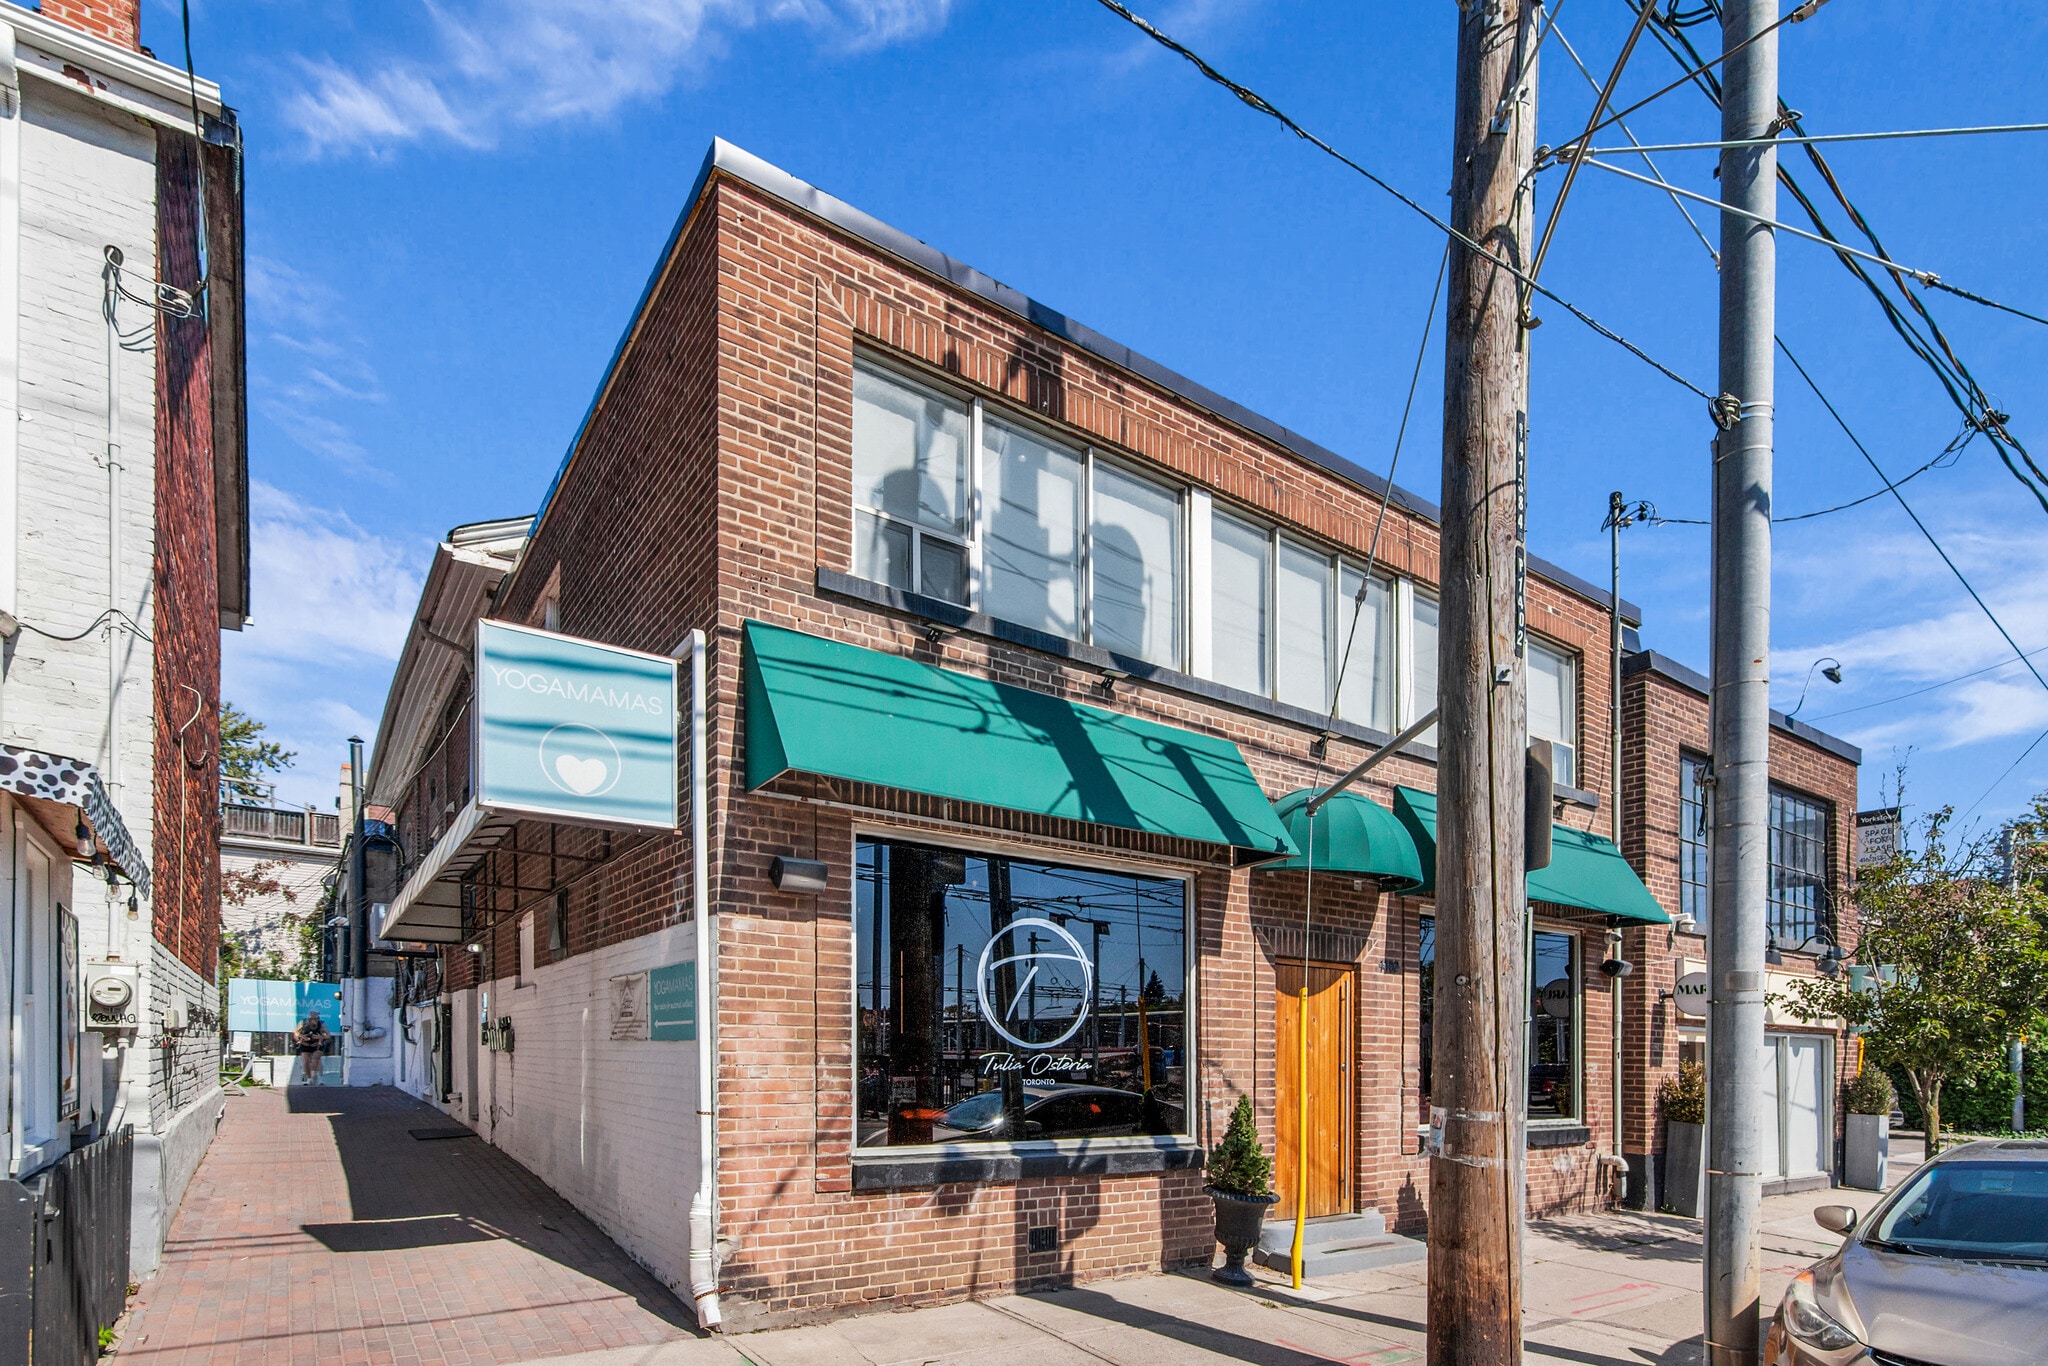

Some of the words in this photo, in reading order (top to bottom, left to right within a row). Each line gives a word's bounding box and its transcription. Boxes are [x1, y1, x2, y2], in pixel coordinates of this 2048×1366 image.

[490, 665, 663, 715] YOGAMAMAS
[653, 975, 693, 995] YOGAMAMAS
[1677, 984, 1707, 995] MAR
[240, 995, 332, 1009] YOGAMAMAS
[979, 1052, 1025, 1075] Tulia
[1027, 1053, 1092, 1075] Osteria
[1022, 1078, 1056, 1086] TORONTO
